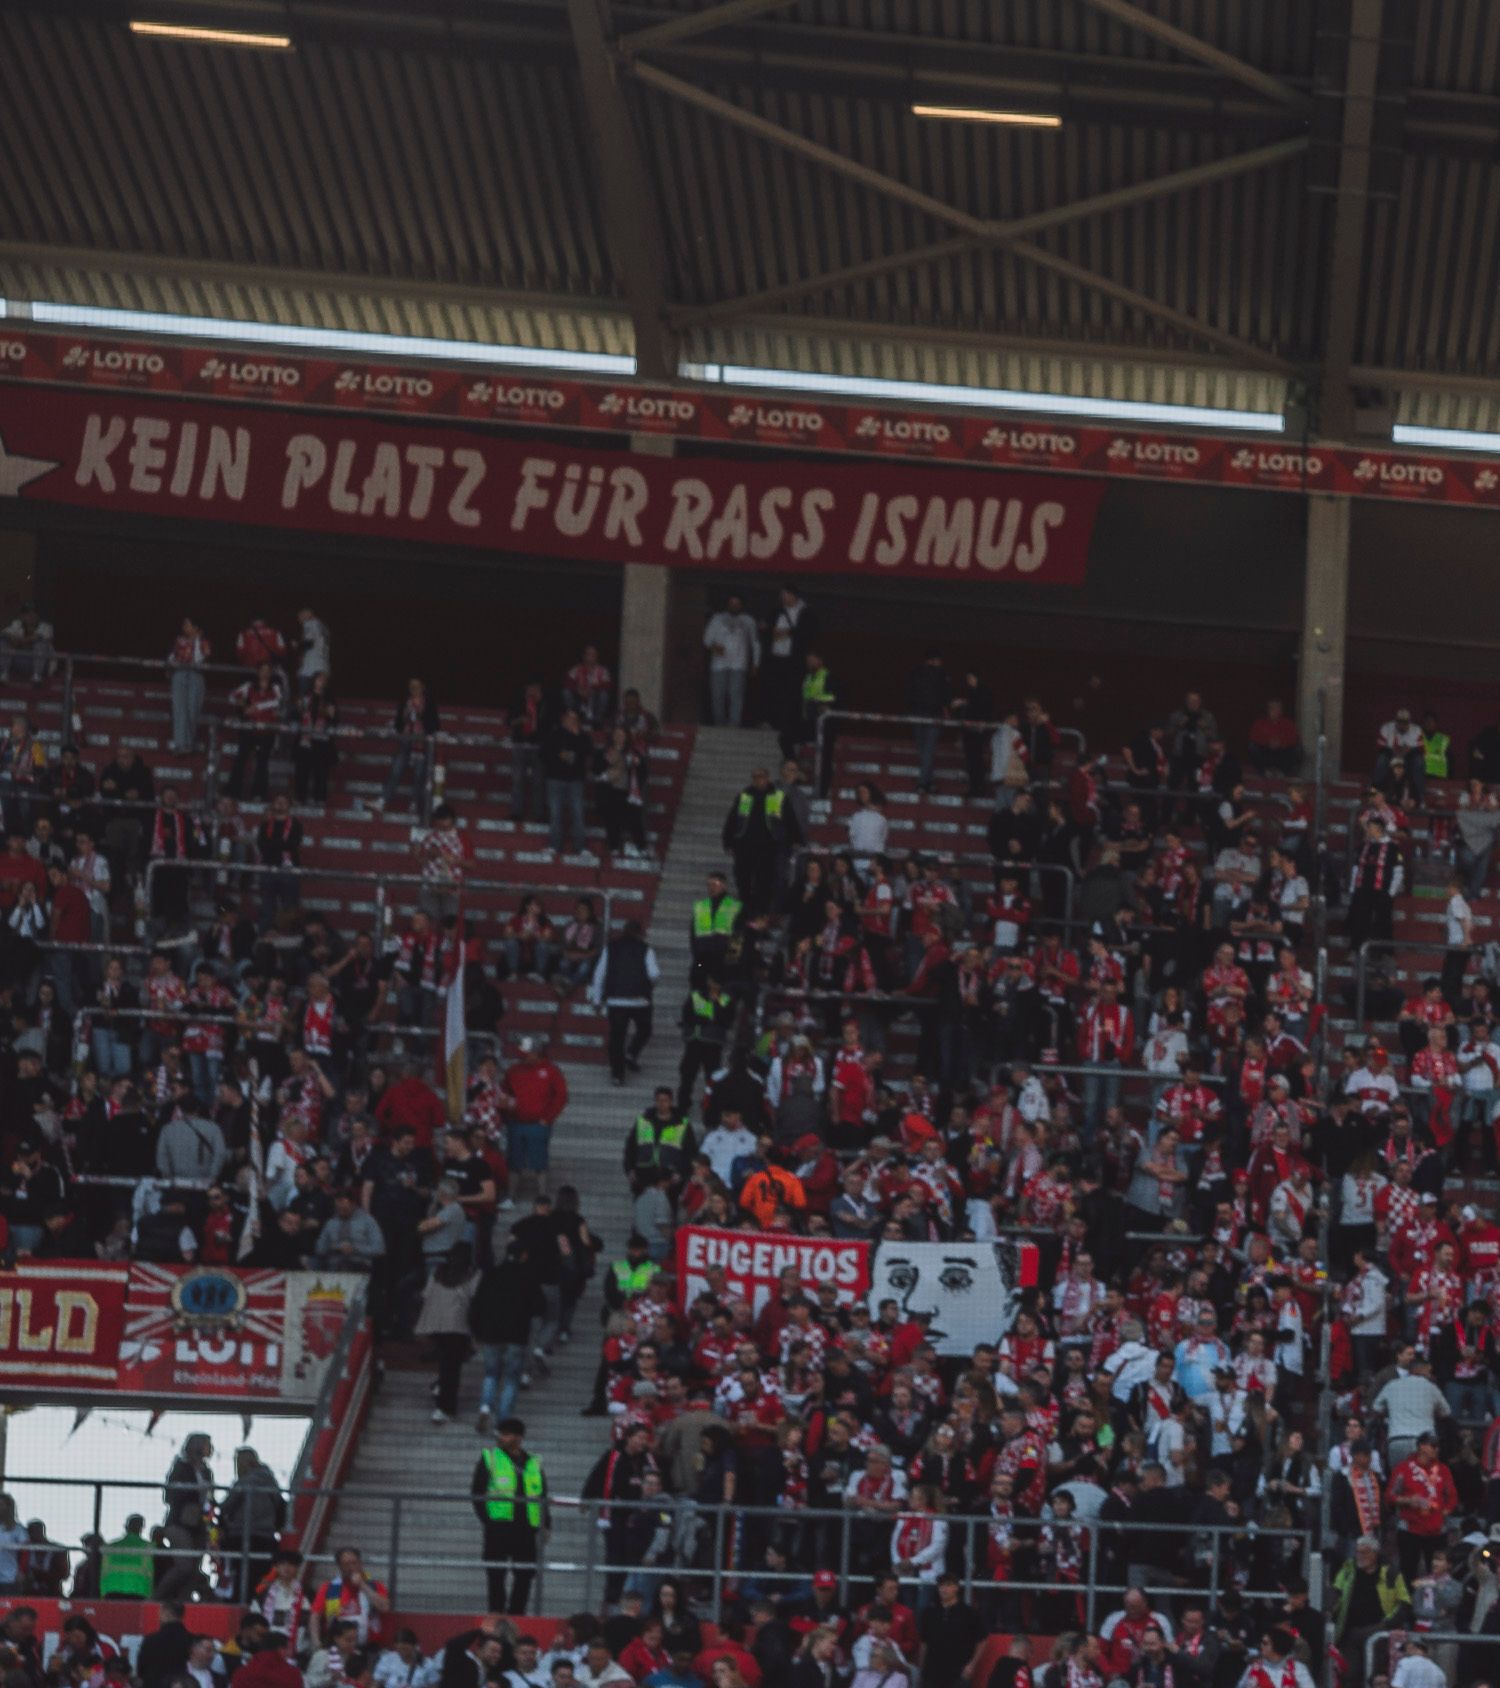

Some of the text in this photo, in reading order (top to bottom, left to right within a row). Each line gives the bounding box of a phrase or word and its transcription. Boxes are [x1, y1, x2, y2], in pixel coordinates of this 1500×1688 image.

[94, 350, 164, 373] LOTTO
[229, 361, 300, 386] LOTTO
[364, 373, 433, 397] LOTTO
[496, 385, 564, 409] LOTTO
[627, 398, 695, 420] LOTTO
[757, 409, 824, 431] LOTTO
[884, 421, 951, 443] LOTTO
[1010, 432, 1076, 454] LOTTO
[1136, 442, 1200, 464] LOTTO
[1259, 453, 1323, 475] LOTTO
[74, 413, 251, 502] KEIN
[282, 433, 486, 528] PLATZ
[512, 456, 648, 545] FÜR
[1380, 464, 1444, 485] LOTTO
